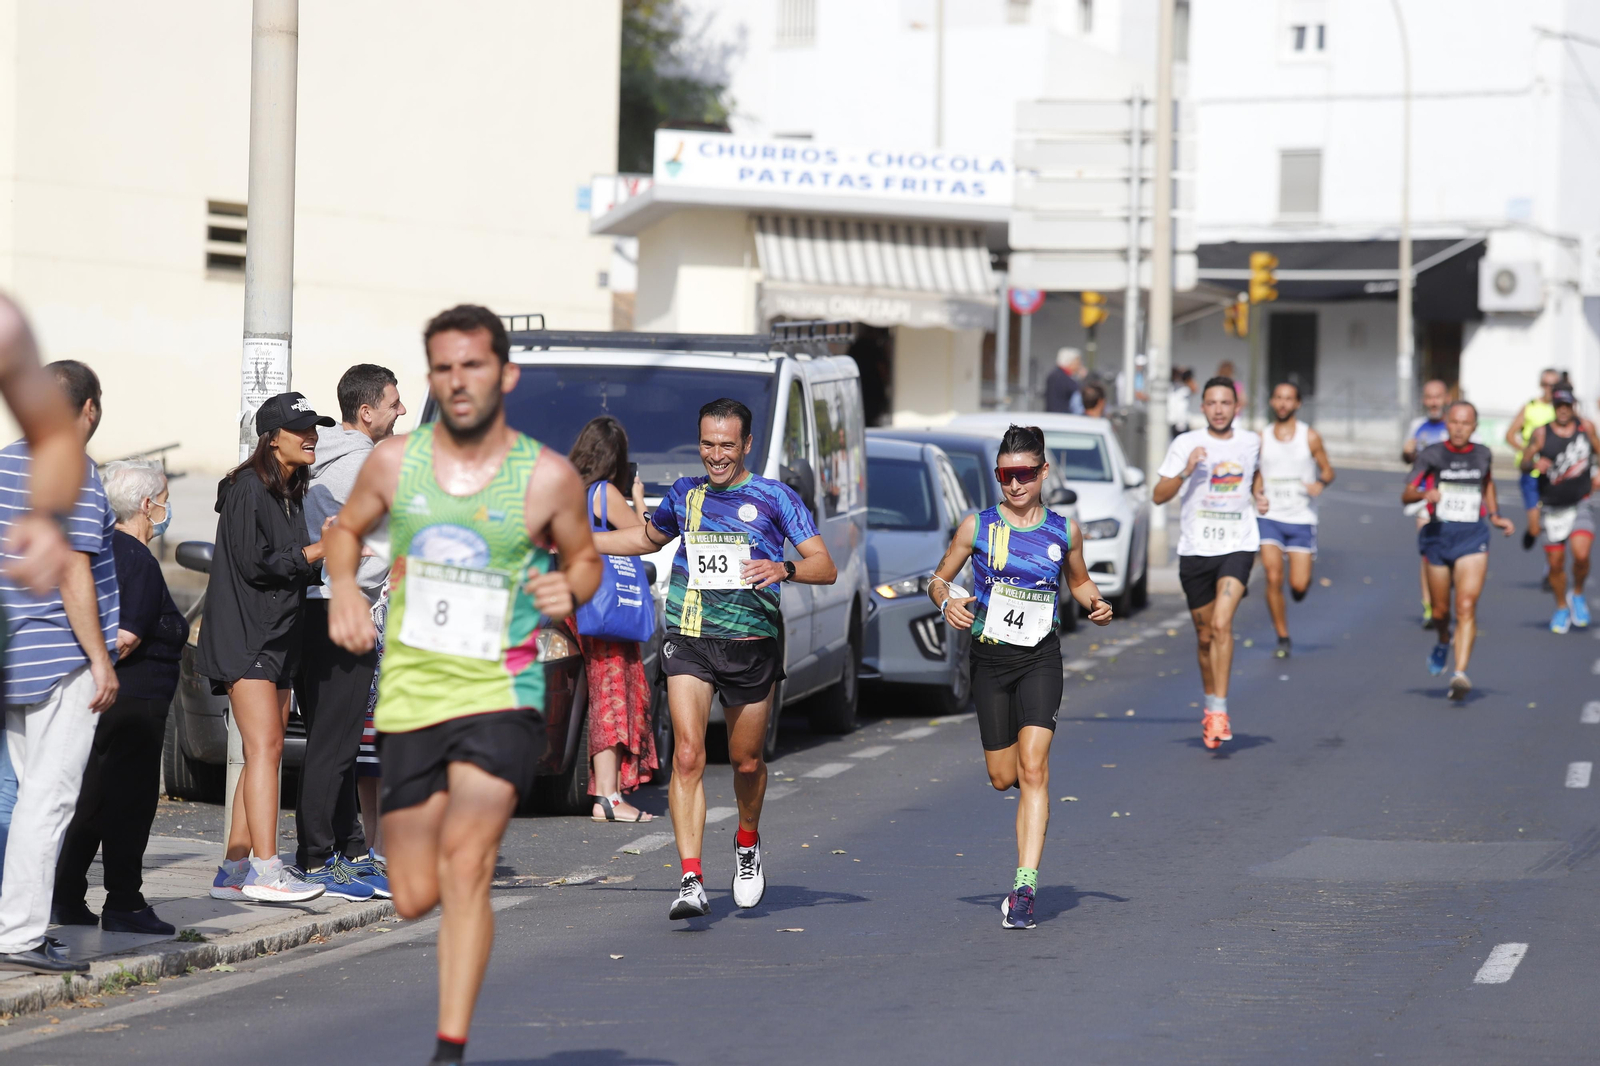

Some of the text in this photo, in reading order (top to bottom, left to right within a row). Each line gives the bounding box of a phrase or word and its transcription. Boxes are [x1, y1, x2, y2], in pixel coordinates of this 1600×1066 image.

[699, 141, 838, 165] CHURROS
[867, 150, 1039, 176] CHOCOLA
[739, 167, 986, 197] PATATAS FRITAS
[696, 534, 717, 543] VUELTA
[718, 534, 723, 543] A
[723, 535, 745, 544] HUELVA
[1203, 526, 1225, 540] 619
[698, 554, 728, 574] 543
[985, 575, 1020, 585] aecc
[1005, 587, 1026, 600] VUELTA
[1026, 592, 1031, 600] A
[1031, 593, 1050, 602] HUELVA
[434, 600, 449, 626] 8
[1003, 608, 1025, 630] 44
